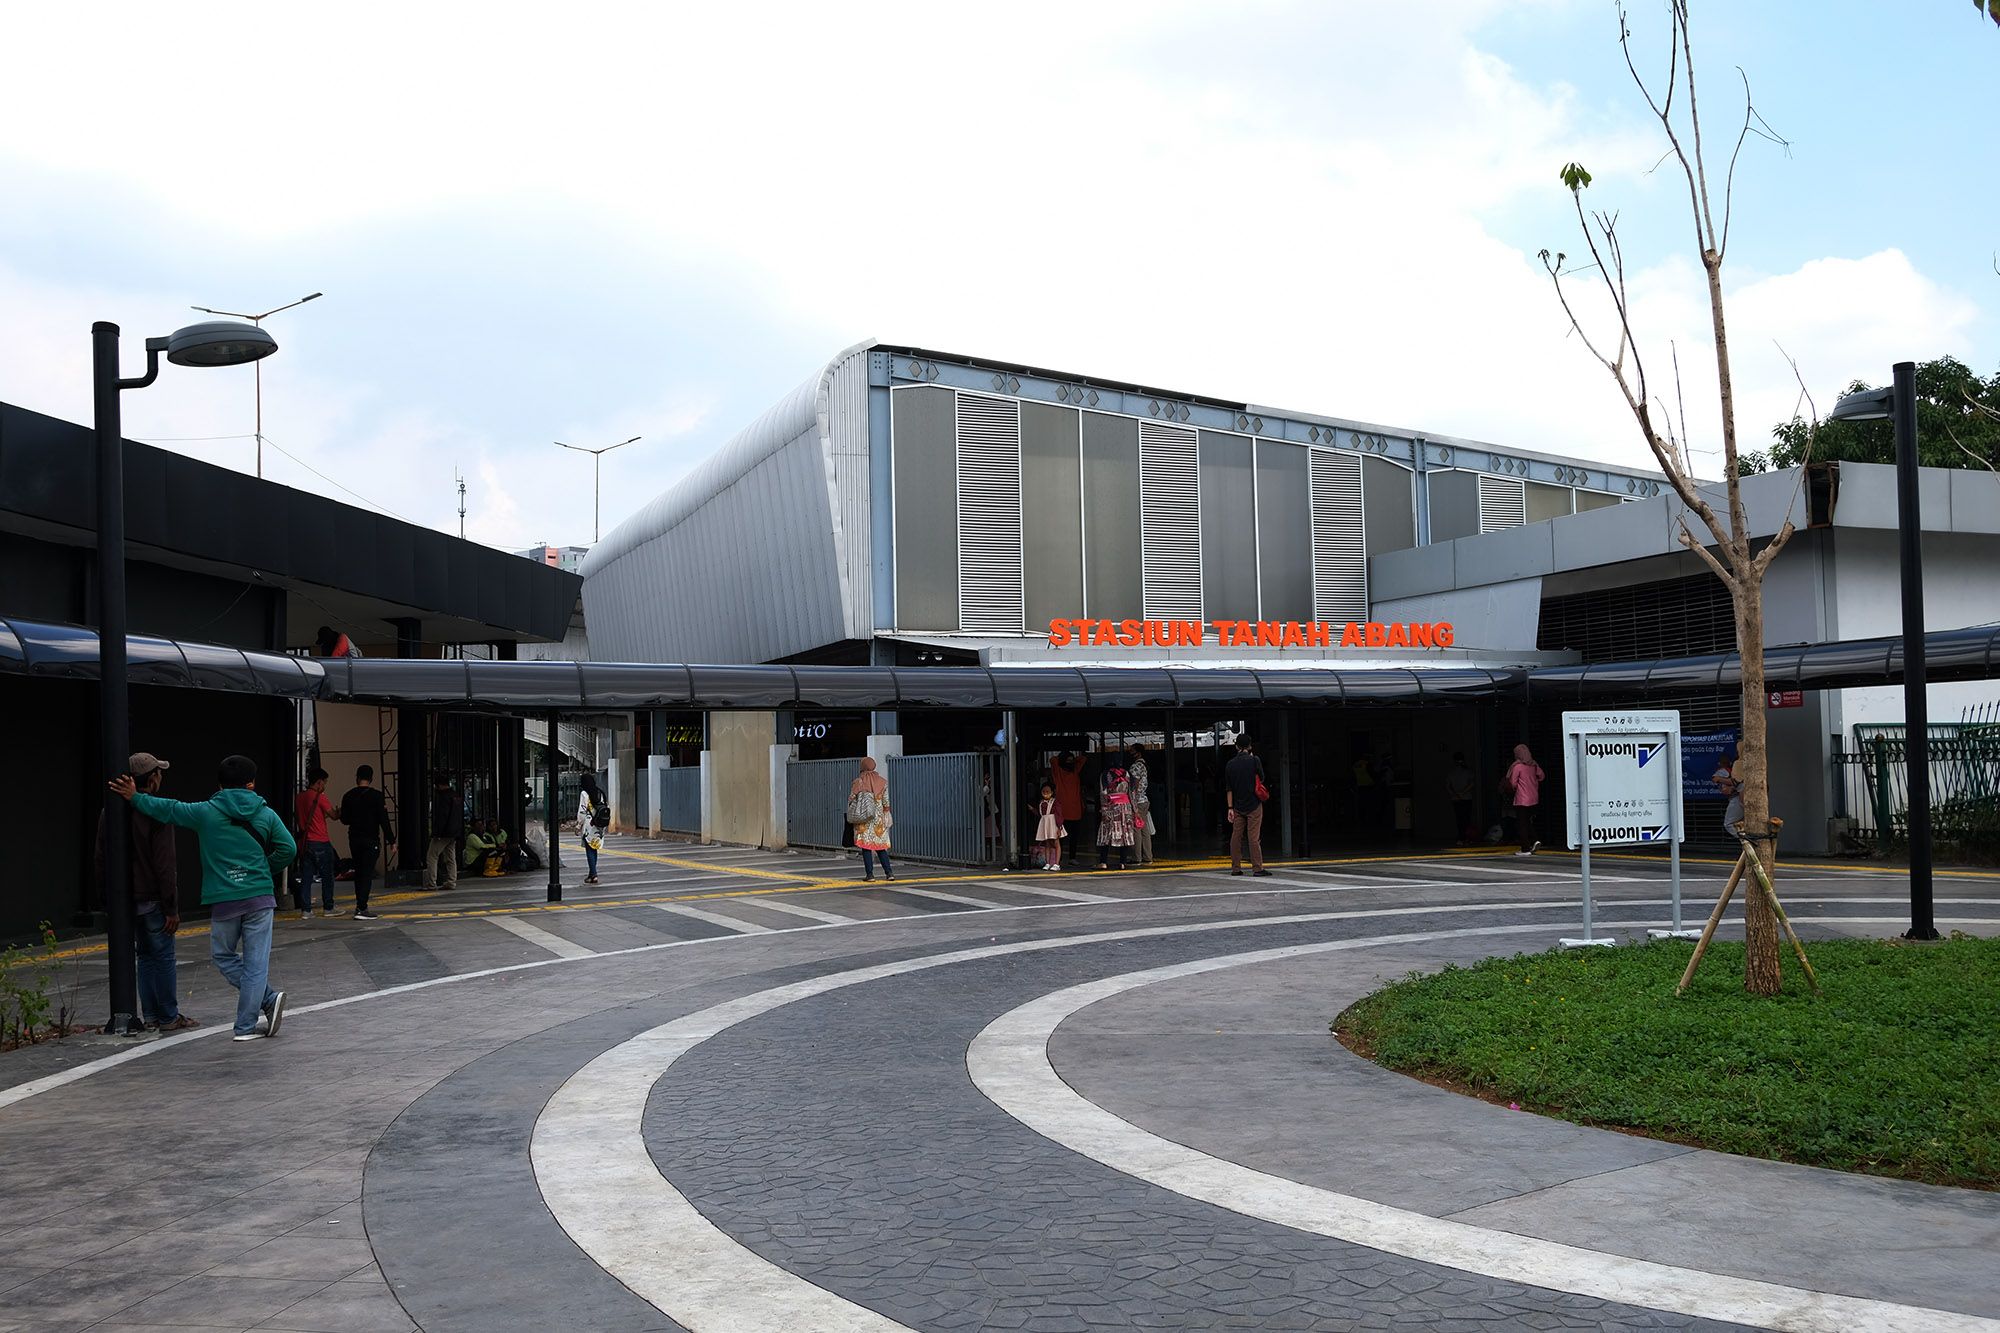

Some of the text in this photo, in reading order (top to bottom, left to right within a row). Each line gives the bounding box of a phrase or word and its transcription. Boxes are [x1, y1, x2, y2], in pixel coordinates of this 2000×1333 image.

[1049, 617, 1455, 648] STASIUN TANAH ABANG
